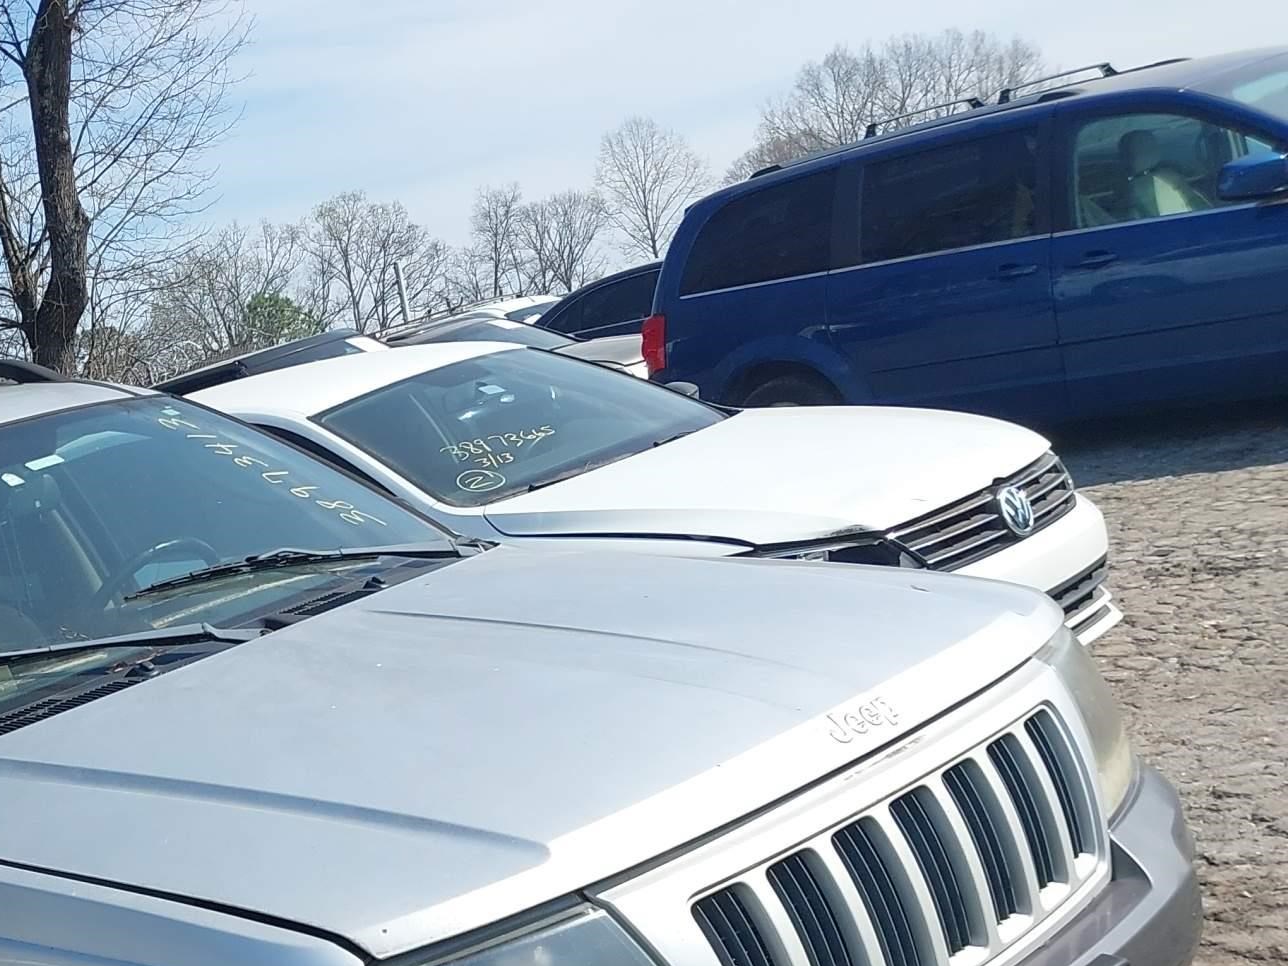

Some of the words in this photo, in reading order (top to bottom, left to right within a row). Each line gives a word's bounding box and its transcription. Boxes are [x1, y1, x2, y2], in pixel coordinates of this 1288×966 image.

[158, 415, 388, 527] 38973413
[474, 452, 515, 468] 3/13
[825, 697, 900, 744] Jeep
